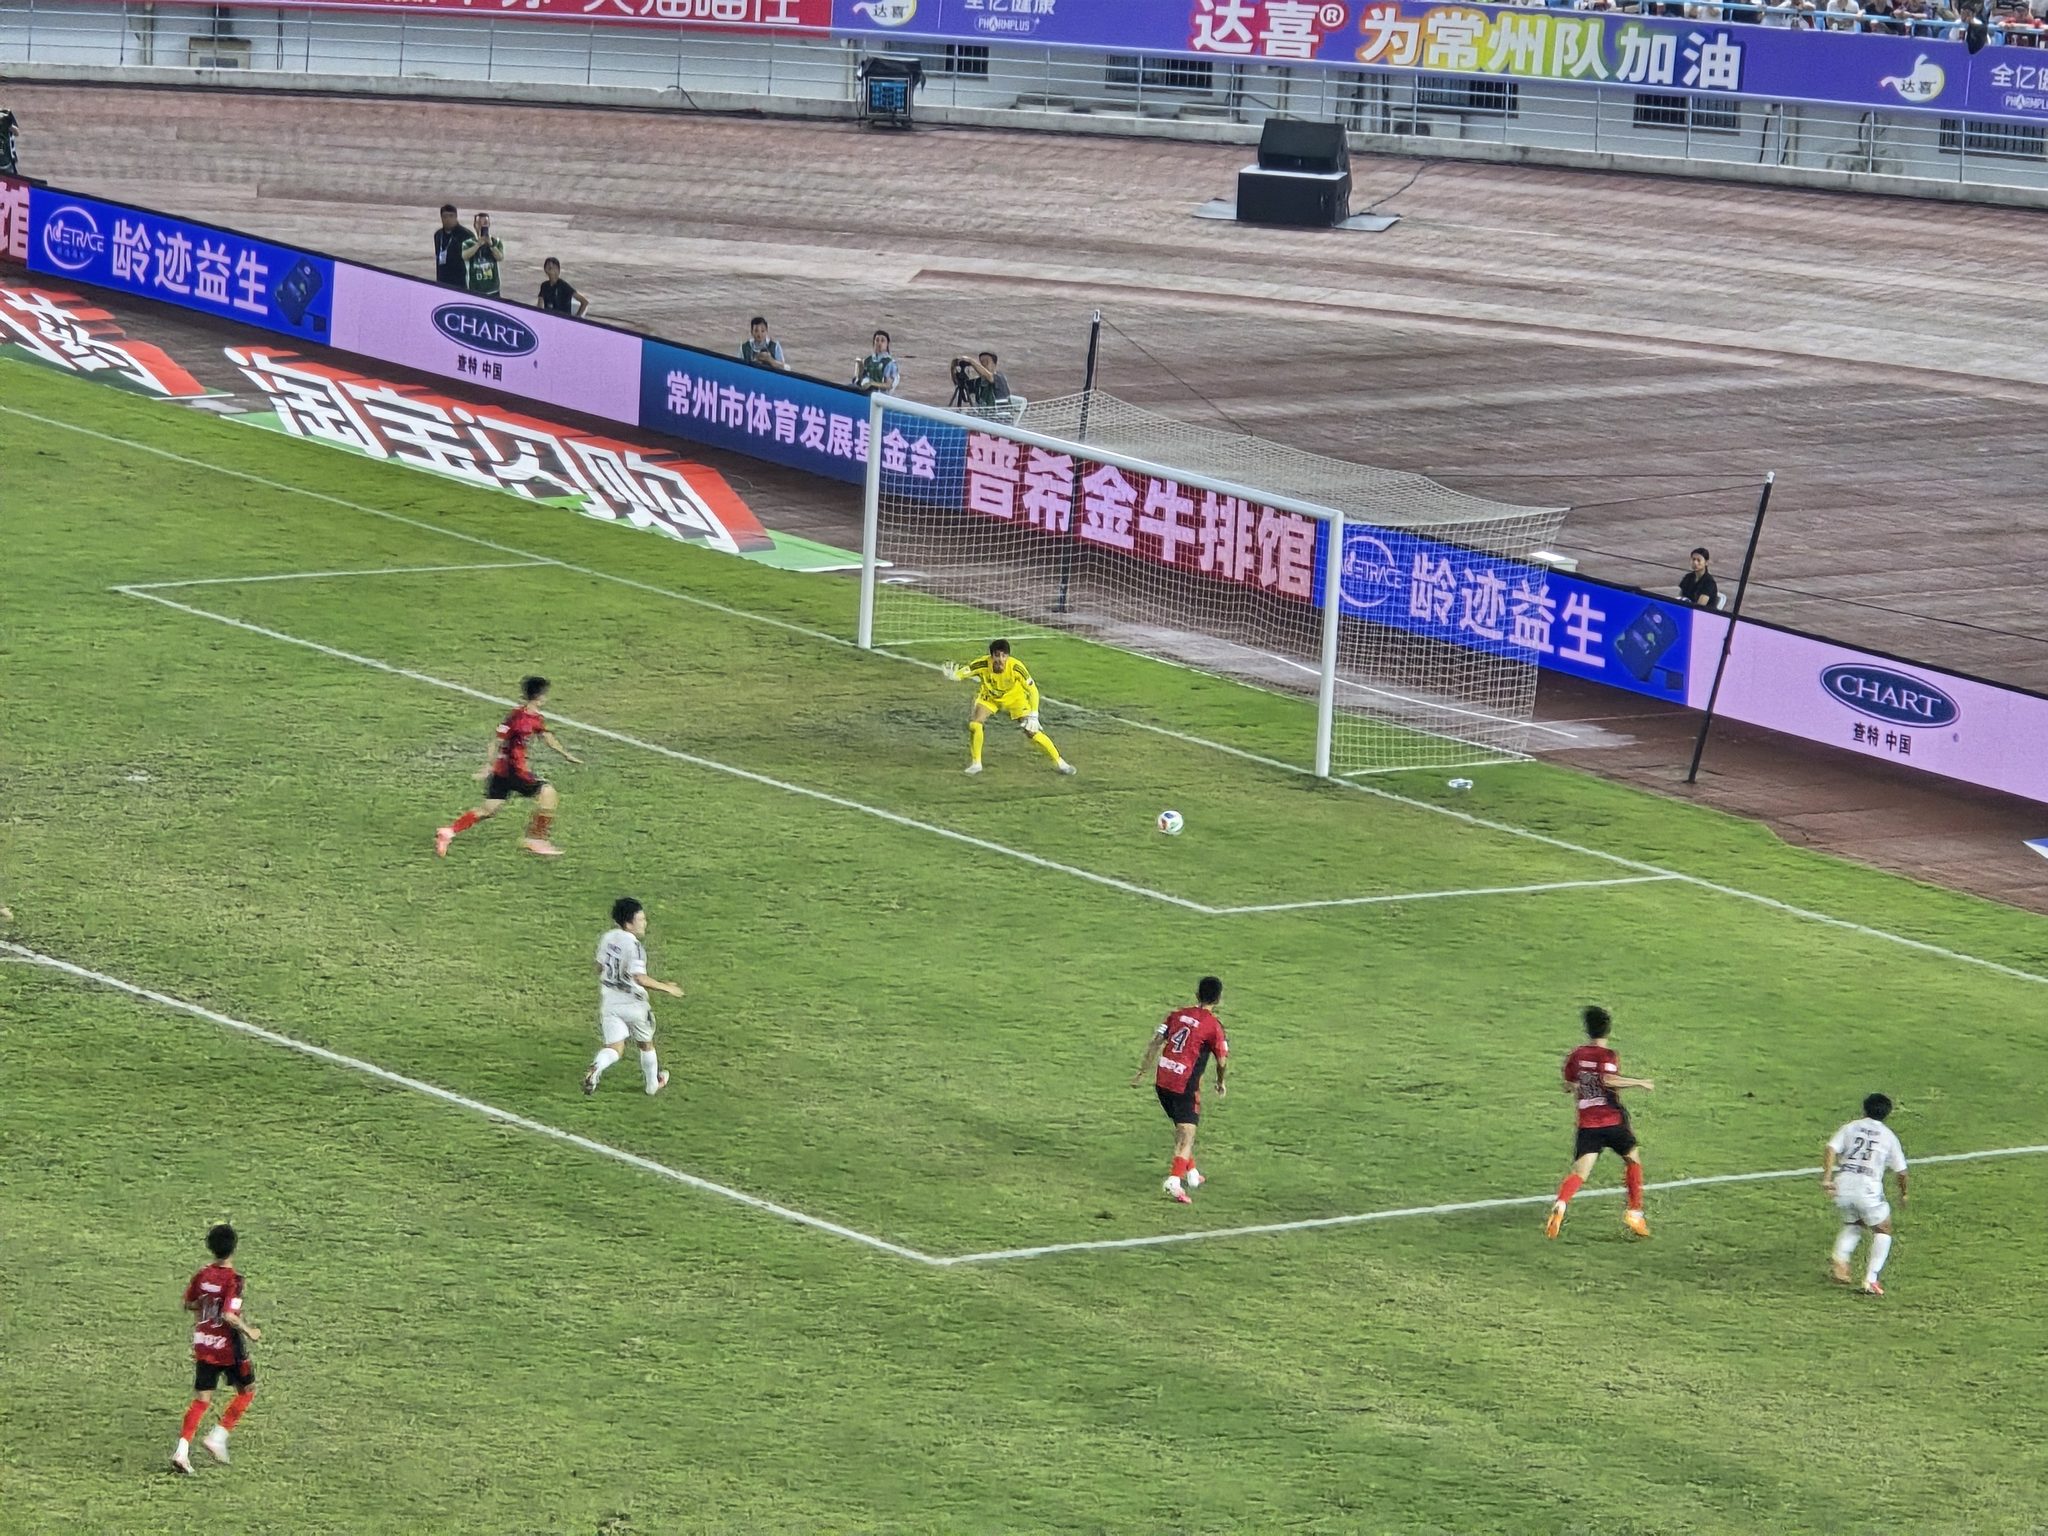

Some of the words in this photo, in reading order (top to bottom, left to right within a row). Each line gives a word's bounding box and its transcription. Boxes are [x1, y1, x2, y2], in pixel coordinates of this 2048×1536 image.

[1362, 8, 1742, 91] 为常州队加油
[112, 218, 268, 315] 龄迹益生
[444, 312, 524, 348] CHART
[224, 347, 739, 553] 淘宝闪购
[666, 370, 937, 480] 常州市体育发展基金会
[967, 432, 1316, 598] 普希金牛排馆
[1410, 552, 1606, 668] 龄迹益生
[1836, 674, 1942, 717] CHART
[1171, 1026, 1190, 1053] 4
